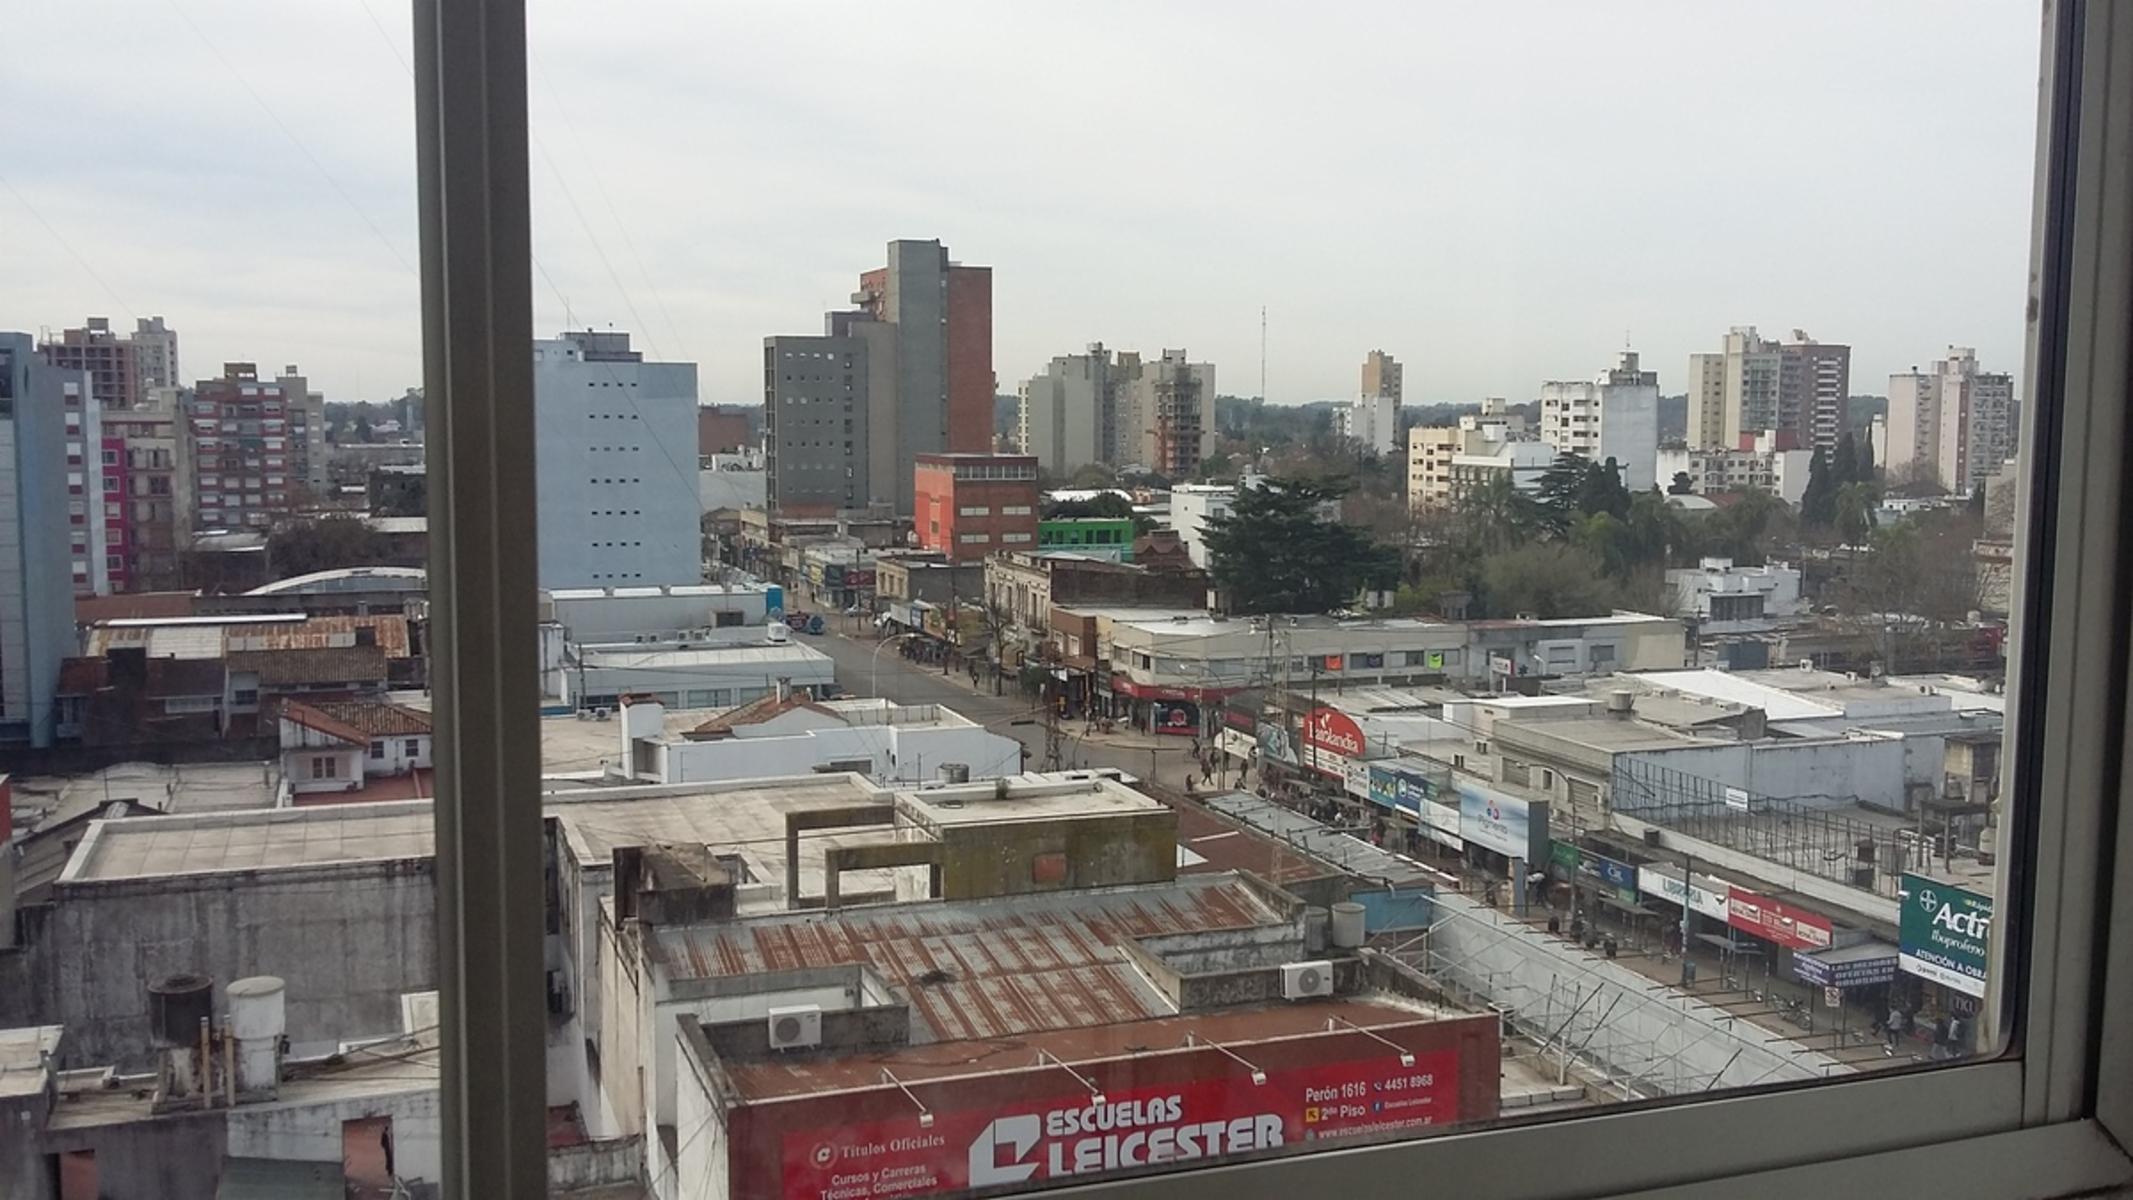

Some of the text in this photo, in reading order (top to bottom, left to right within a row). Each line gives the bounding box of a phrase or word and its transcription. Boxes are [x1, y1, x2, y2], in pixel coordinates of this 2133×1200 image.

[1931, 929, 1986, 957] Ibuprofeno
[1915, 949, 1956, 970] ATENCIÓN
[1956, 961, 1964, 972] A
[1306, 1082, 1366, 1102] Perón 1616
[1384, 1077, 1407, 1091] 4451
[1047, 1095, 1181, 1136] ESCUELAS
[1340, 1105, 1366, 1118] Piso
[842, 1135, 945, 1159] Títulos Oficiales
[1049, 1114, 1284, 1177] LEICESTER
[831, 1164, 927, 1186] Cursos y Carreras
[820, 1185, 871, 1200] Técnicas,
[874, 1175, 938, 1194] Comerciales
